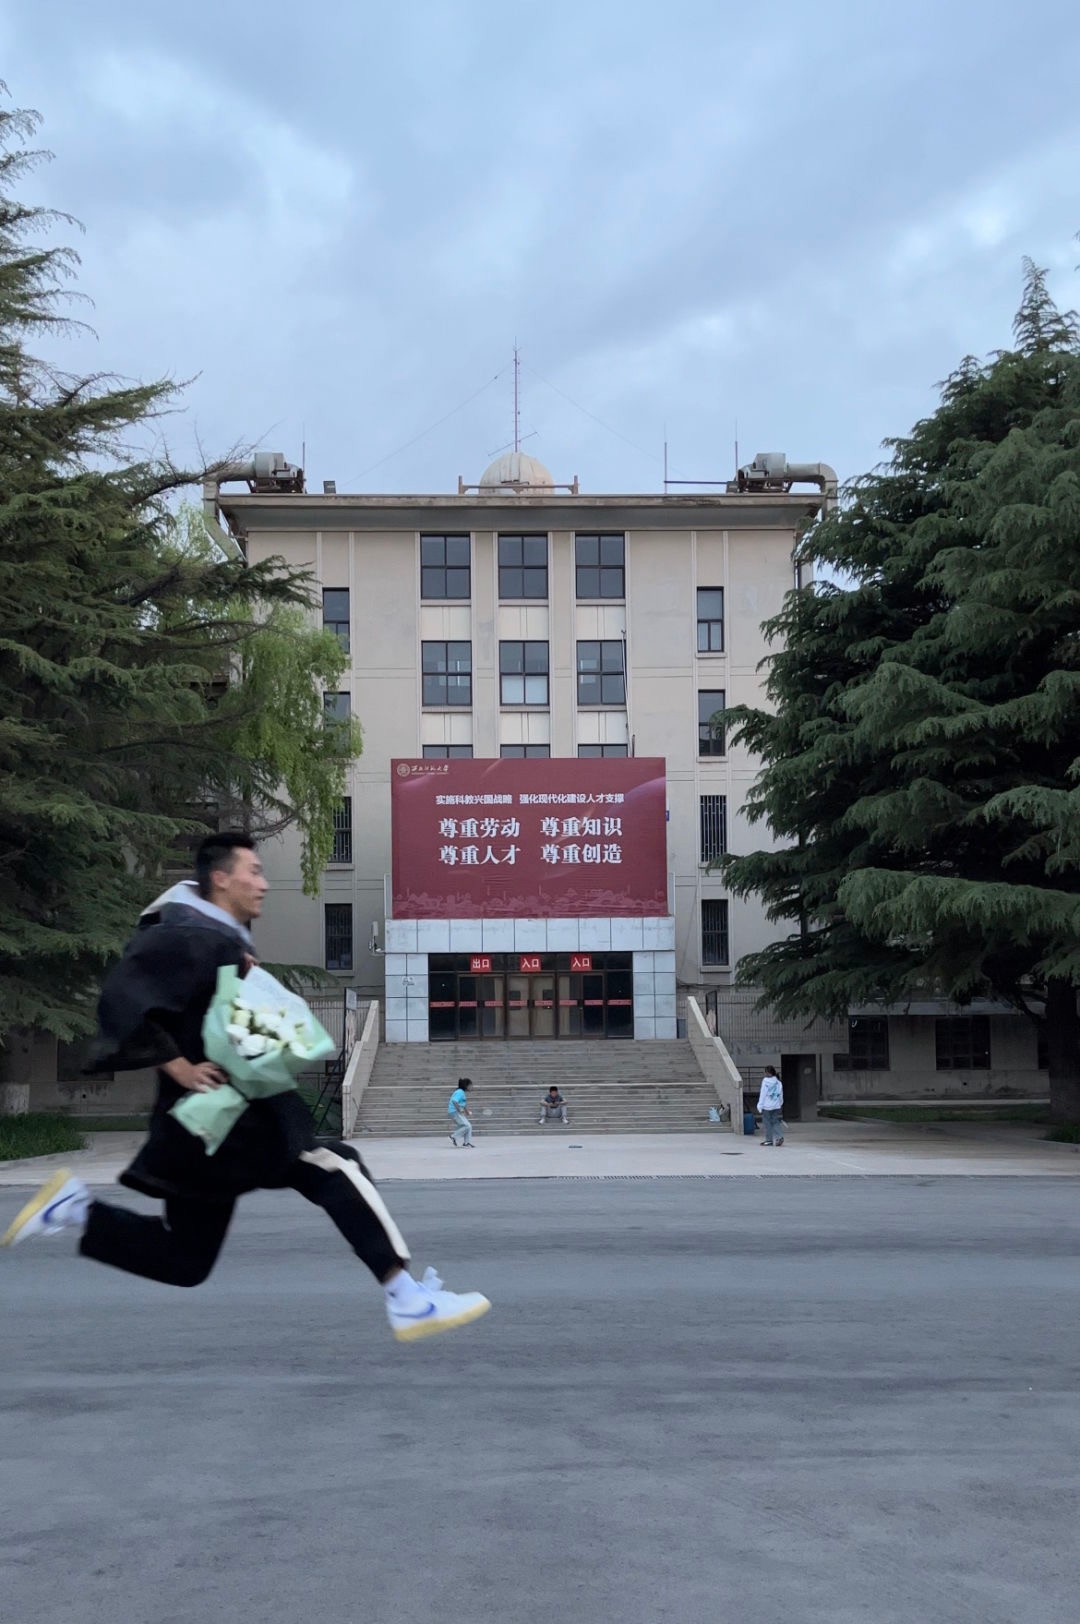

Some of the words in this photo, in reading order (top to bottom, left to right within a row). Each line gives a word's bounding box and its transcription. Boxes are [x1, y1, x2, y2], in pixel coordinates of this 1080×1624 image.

[438, 817, 520, 838] 尊重劳动
[540, 816, 623, 837] 尊重知识
[438, 845, 521, 866] 尊重人才
[540, 843, 623, 865] 尊重创造
[472, 958, 490, 969] 出口
[521, 957, 540, 968] 入口
[572, 957, 591, 968] 入口
